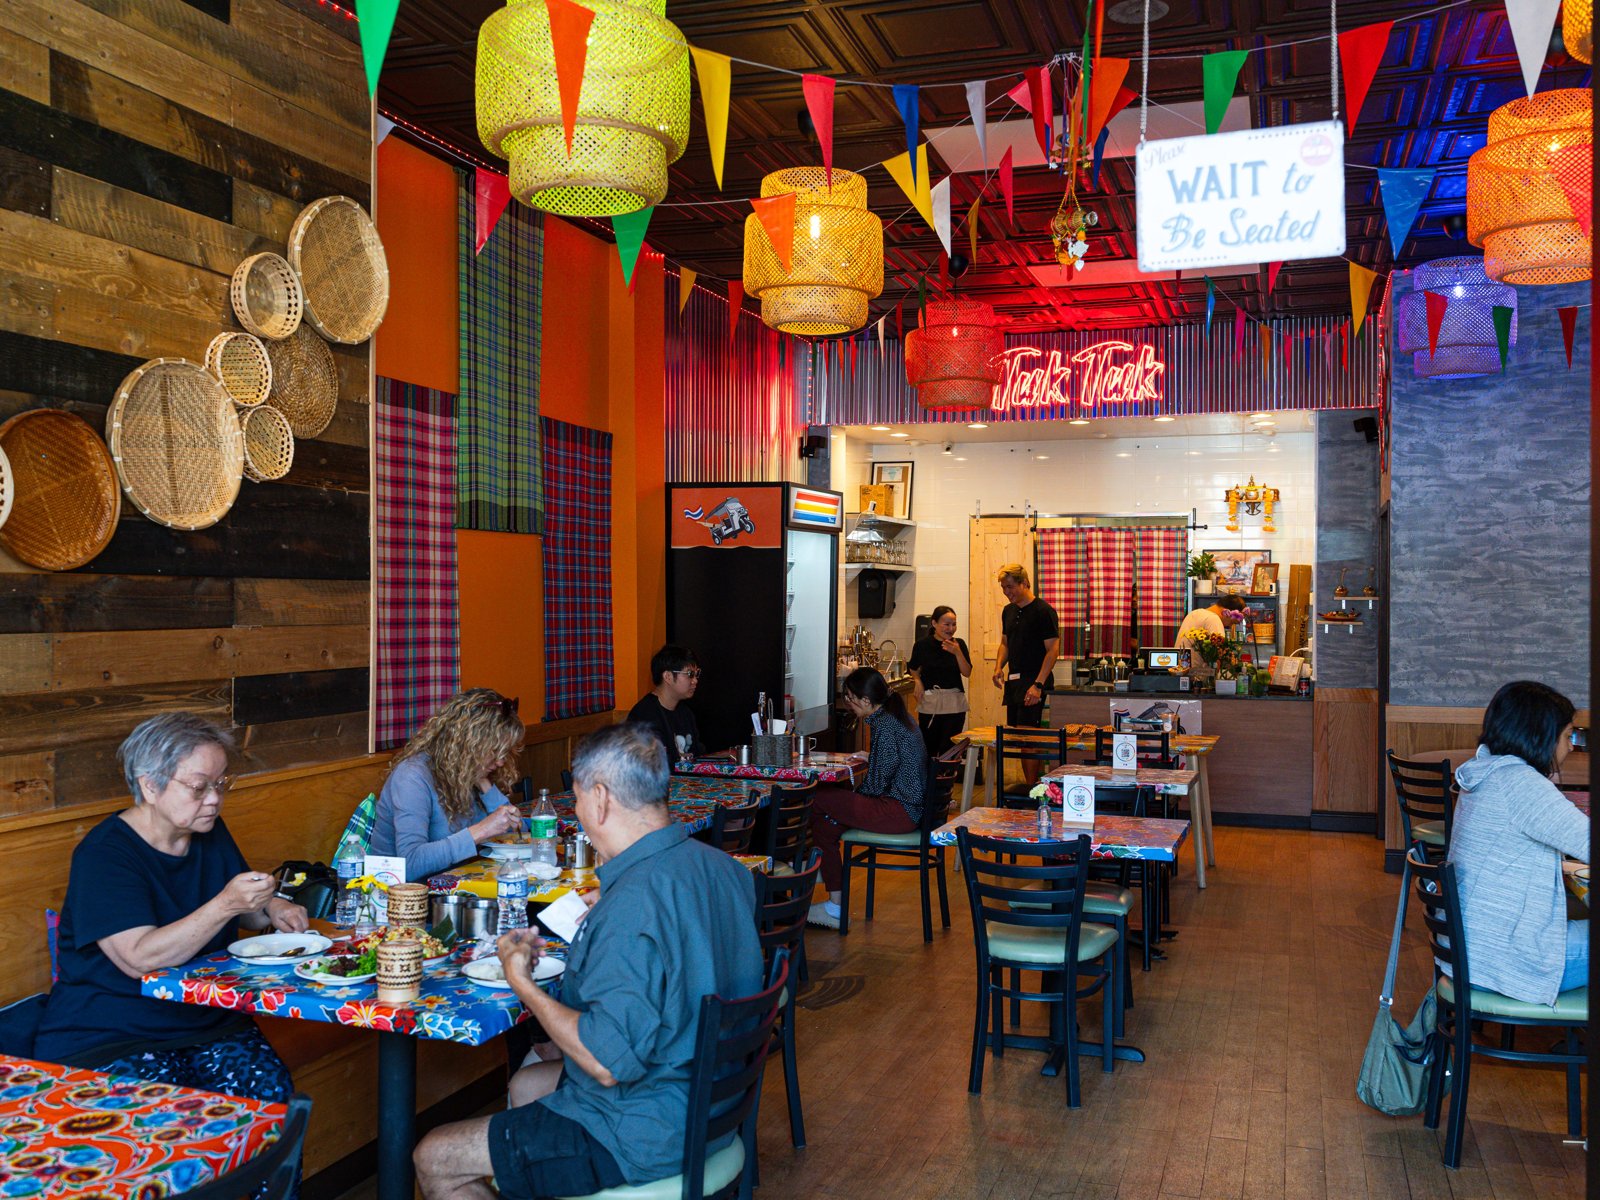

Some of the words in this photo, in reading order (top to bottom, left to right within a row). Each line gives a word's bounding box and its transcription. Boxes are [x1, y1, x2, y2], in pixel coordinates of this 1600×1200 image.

[1143, 142, 1187, 171] Please
[1166, 159, 1268, 204] WAIT
[1281, 161, 1316, 195] to
[1160, 212, 1207, 253] Be
[1218, 207, 1322, 248] Seated
[986, 346, 1072, 411] Tuk
[1071, 340, 1165, 407] Tuk
